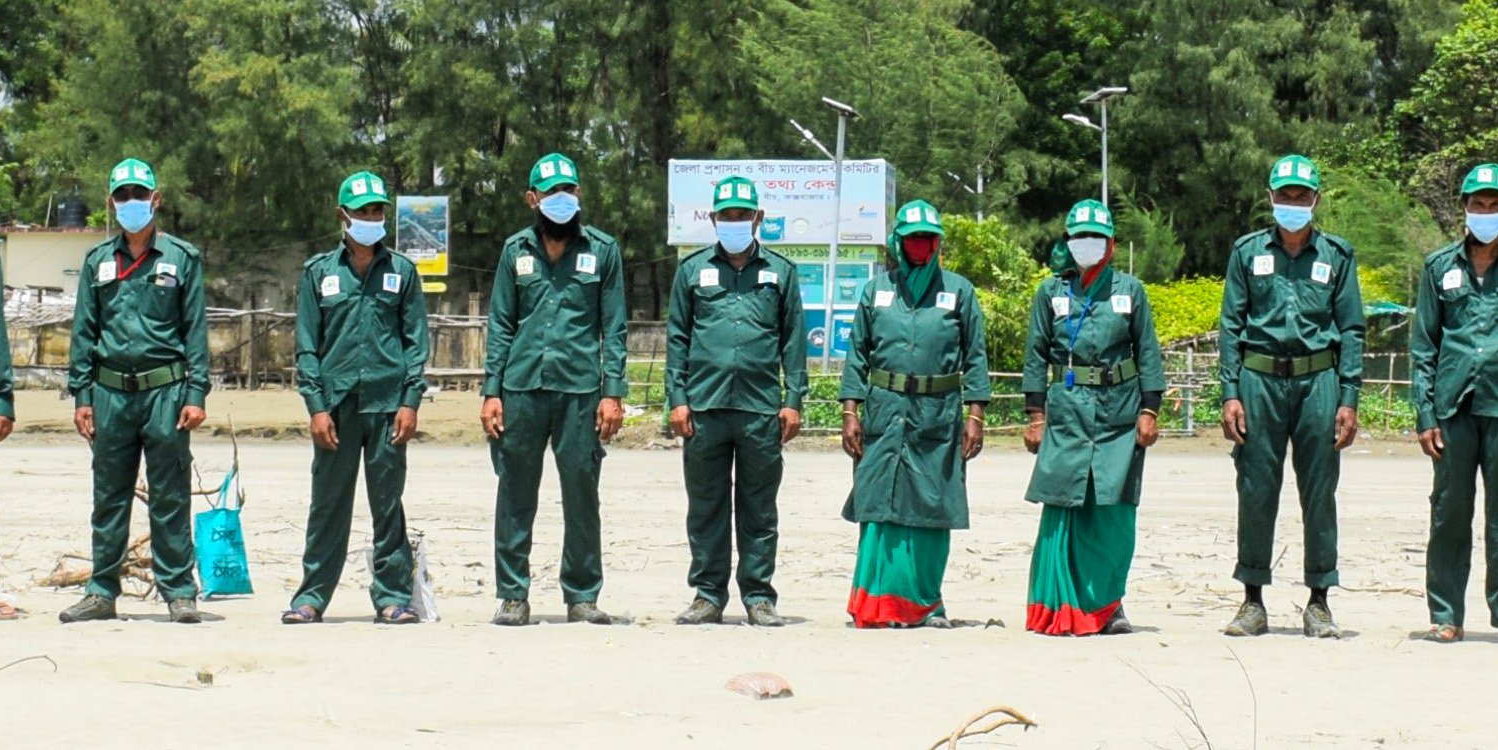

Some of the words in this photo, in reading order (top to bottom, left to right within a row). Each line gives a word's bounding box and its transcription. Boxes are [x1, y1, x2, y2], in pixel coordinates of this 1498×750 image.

[673, 164, 700, 174] জেলা
[704, 164, 740, 175] প্রশাসন
[745, 165, 753, 173] ও
[758, 162, 775, 174] বীচ
[842, 162, 880, 174] কমিটির
[763, 180, 797, 190] তথ্য
